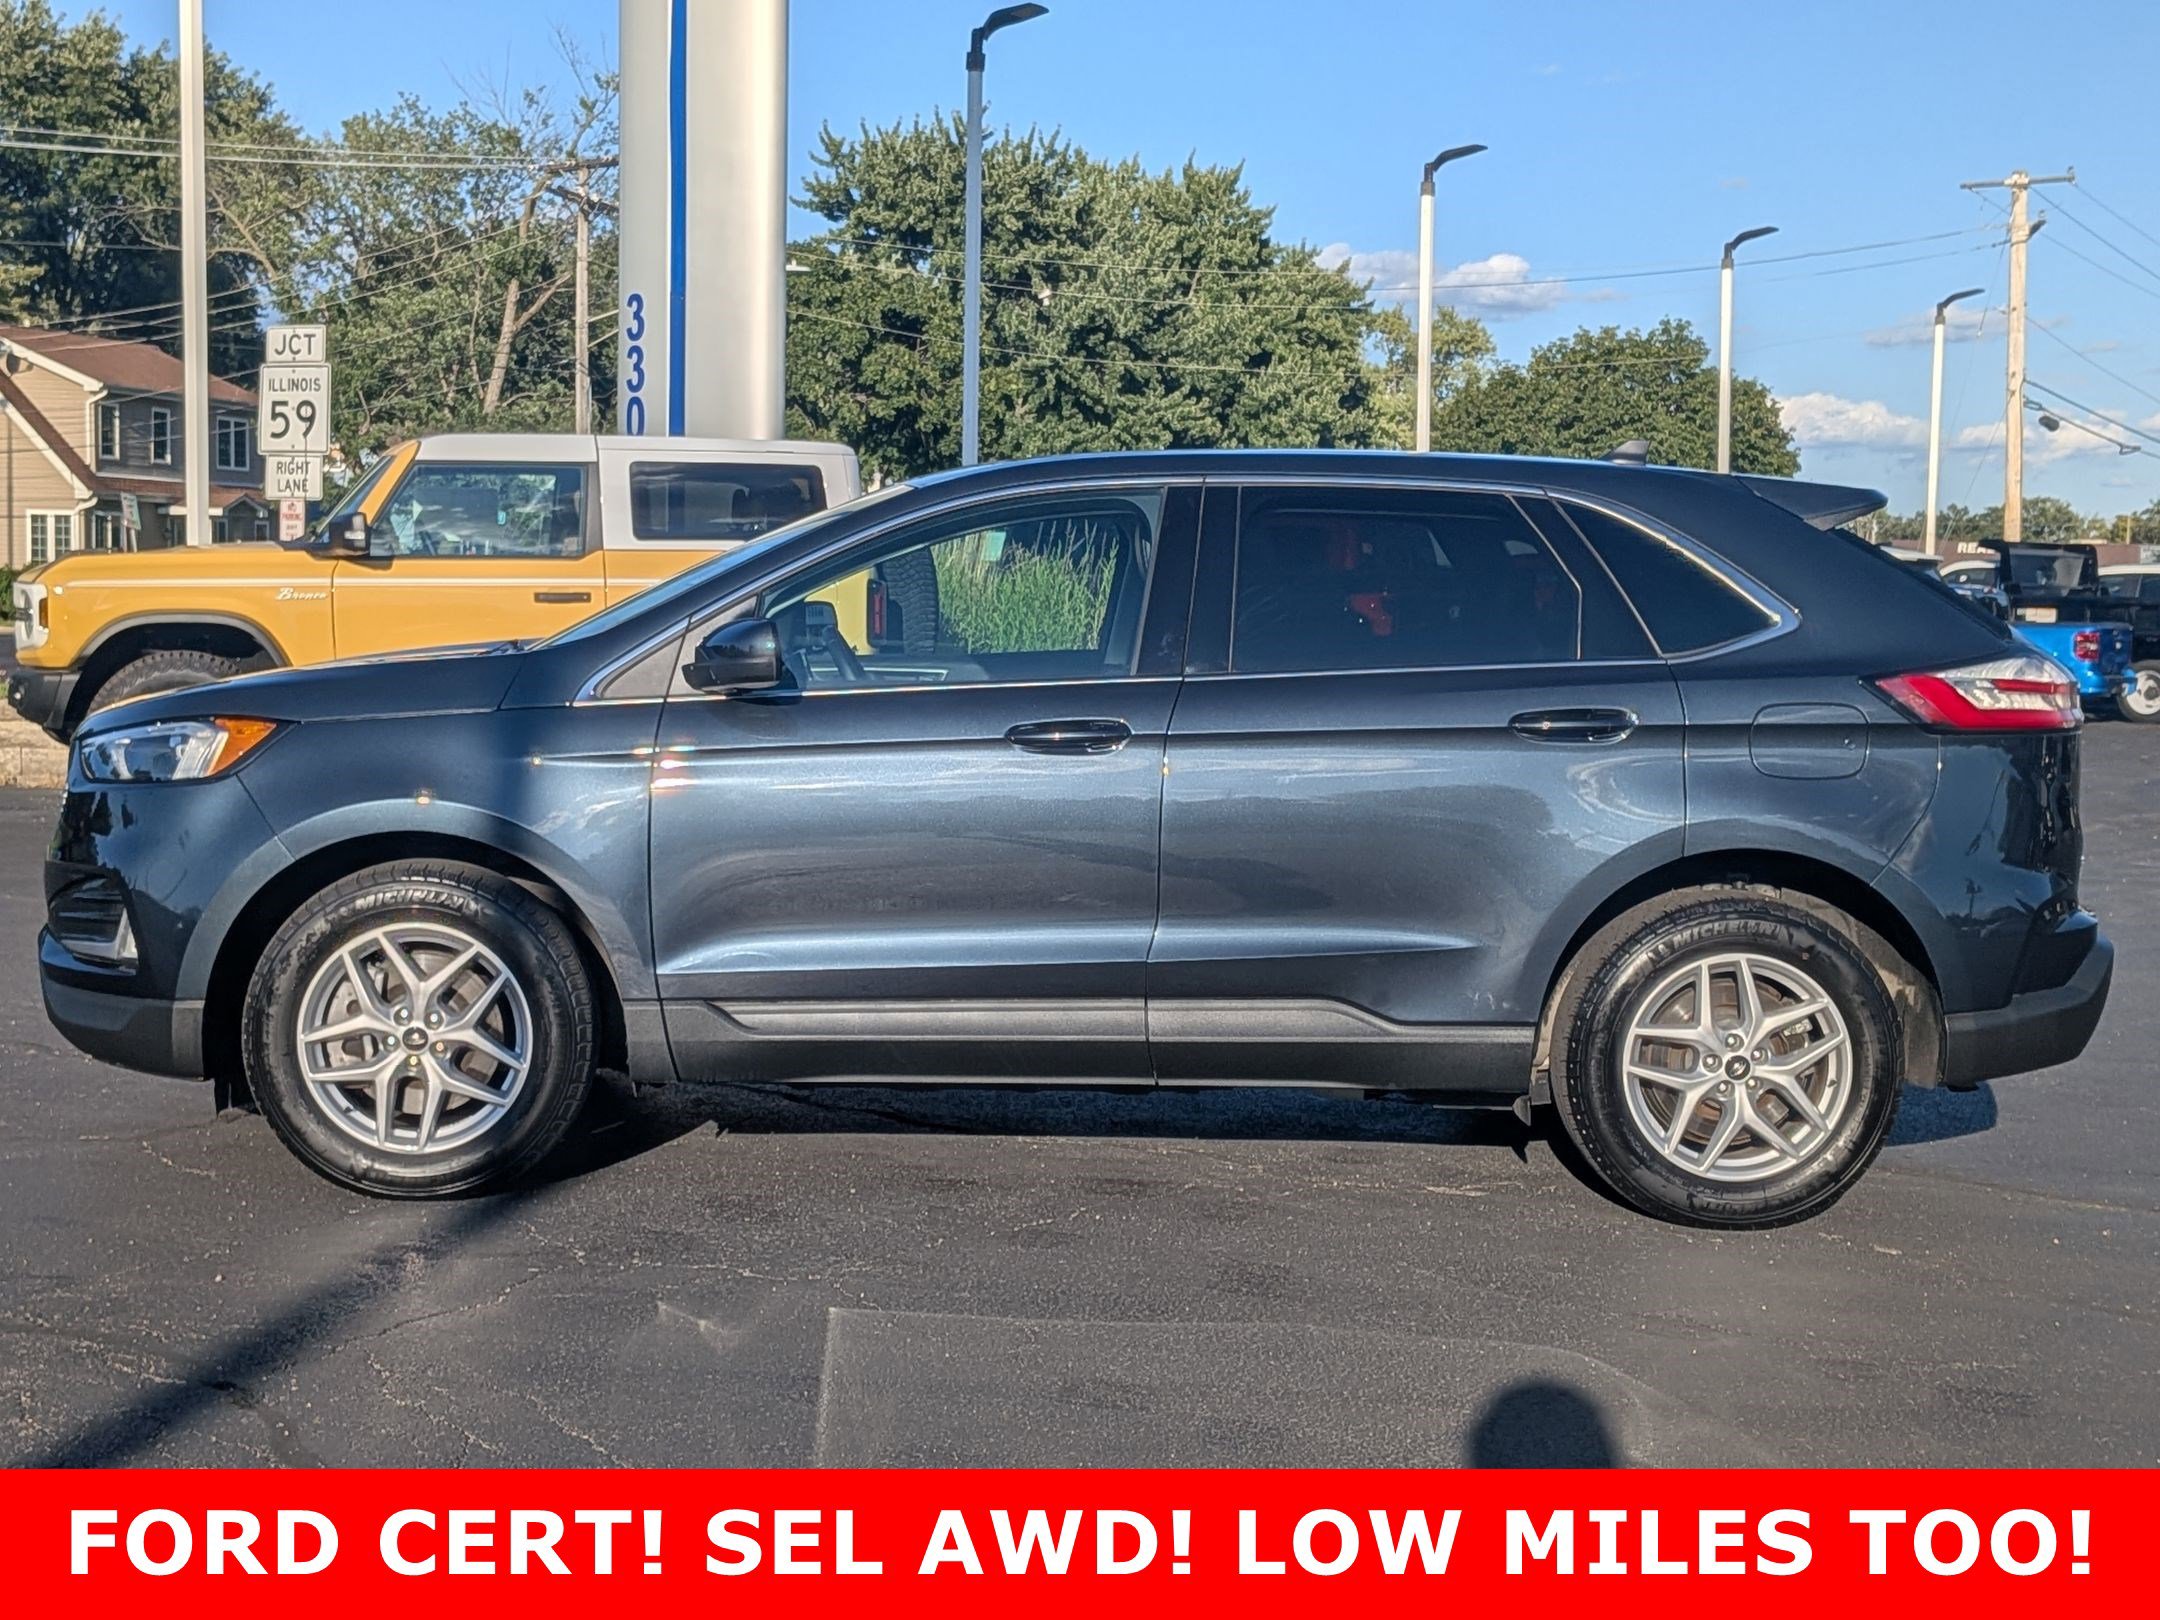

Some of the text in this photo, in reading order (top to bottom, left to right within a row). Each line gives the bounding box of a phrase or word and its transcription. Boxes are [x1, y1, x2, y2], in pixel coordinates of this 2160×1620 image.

[274, 333, 317, 356] JCT
[625, 293, 646, 436] 330
[268, 377, 322, 393] ILLINOIS
[270, 400, 317, 439] 59
[276, 461, 312, 476] RIGHT
[277, 479, 310, 493] LANE
